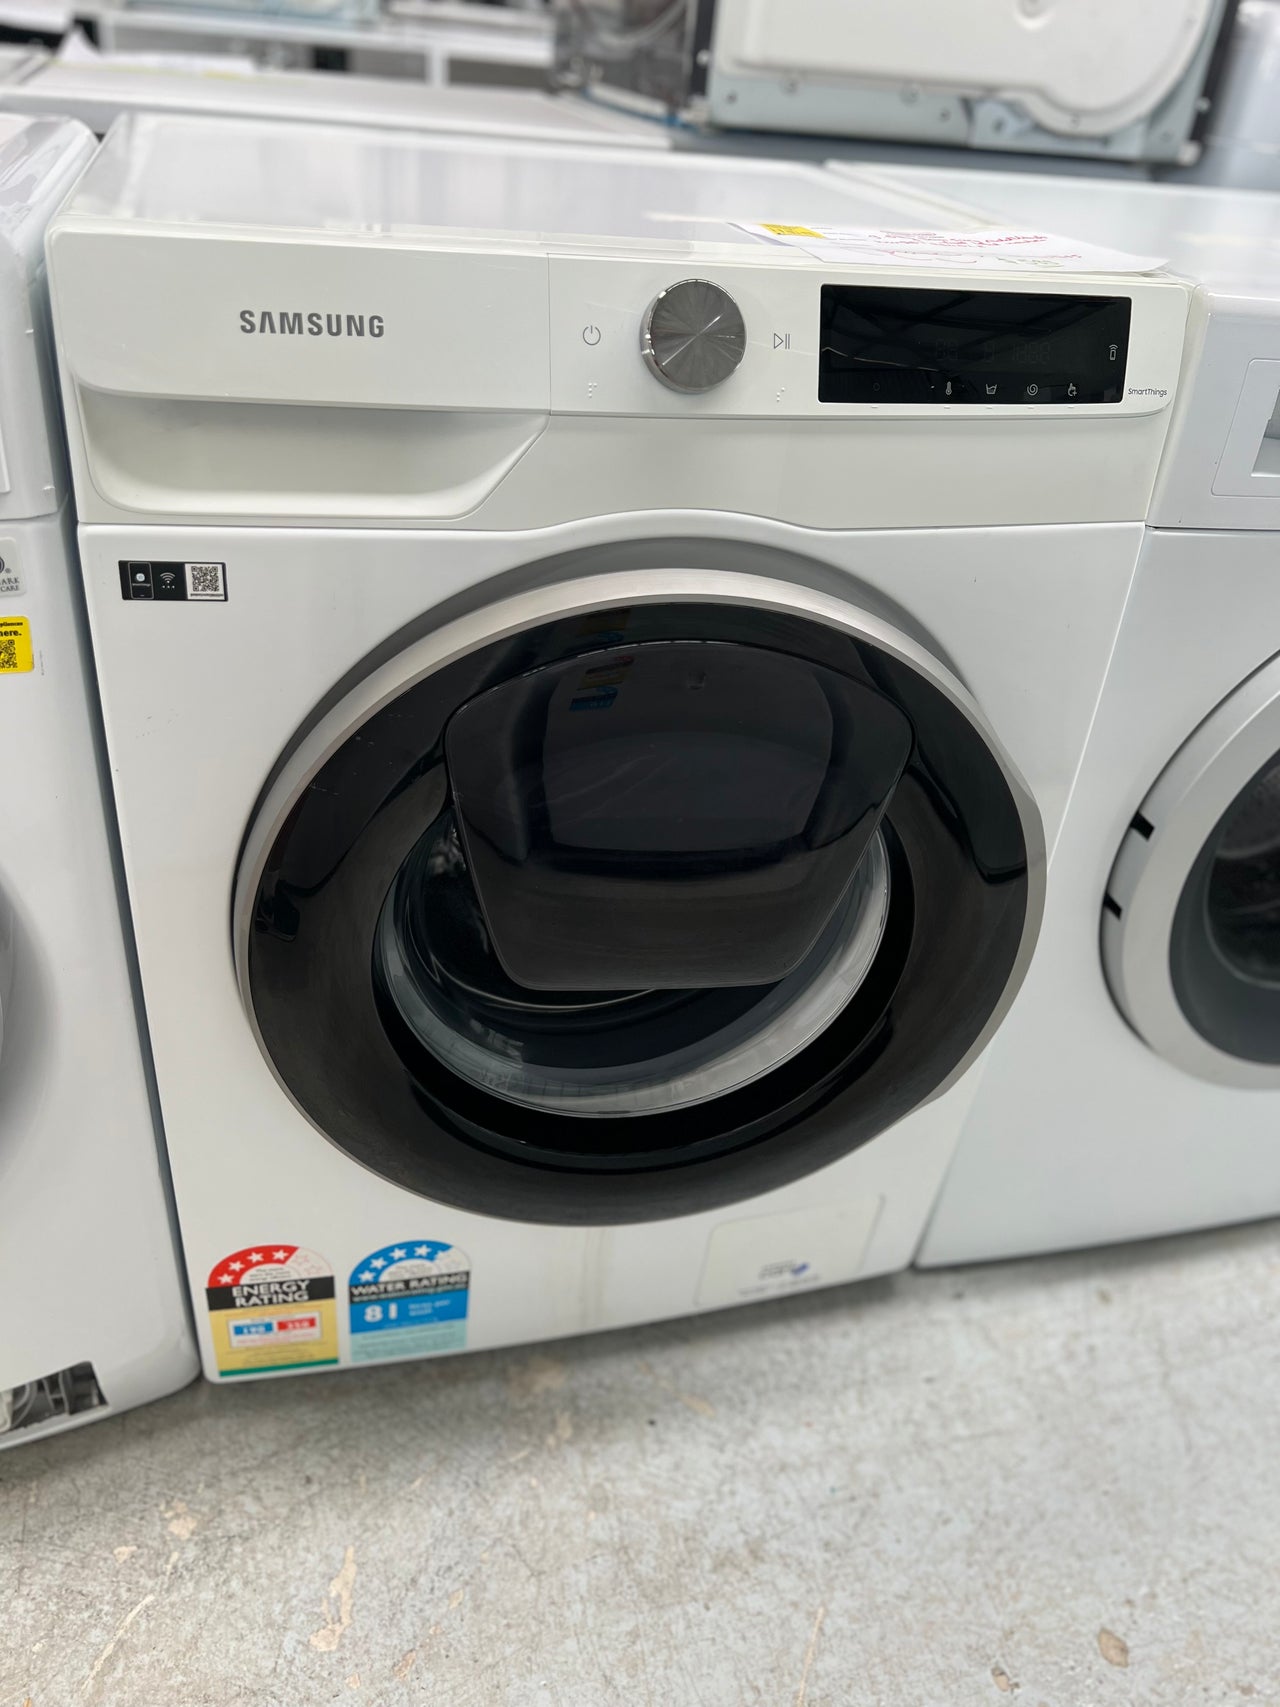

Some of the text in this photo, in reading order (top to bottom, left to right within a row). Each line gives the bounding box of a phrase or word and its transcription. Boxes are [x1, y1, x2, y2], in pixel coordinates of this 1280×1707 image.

[239, 310, 384, 338] SAMSUNG
[1128, 388, 1168, 398] SmartThings
[0, 576, 20, 586] ARK
[232, 1280, 310, 1298] ENERGY
[351, 1273, 467, 1296] WATER RATING
[235, 1290, 309, 1307] RATING
